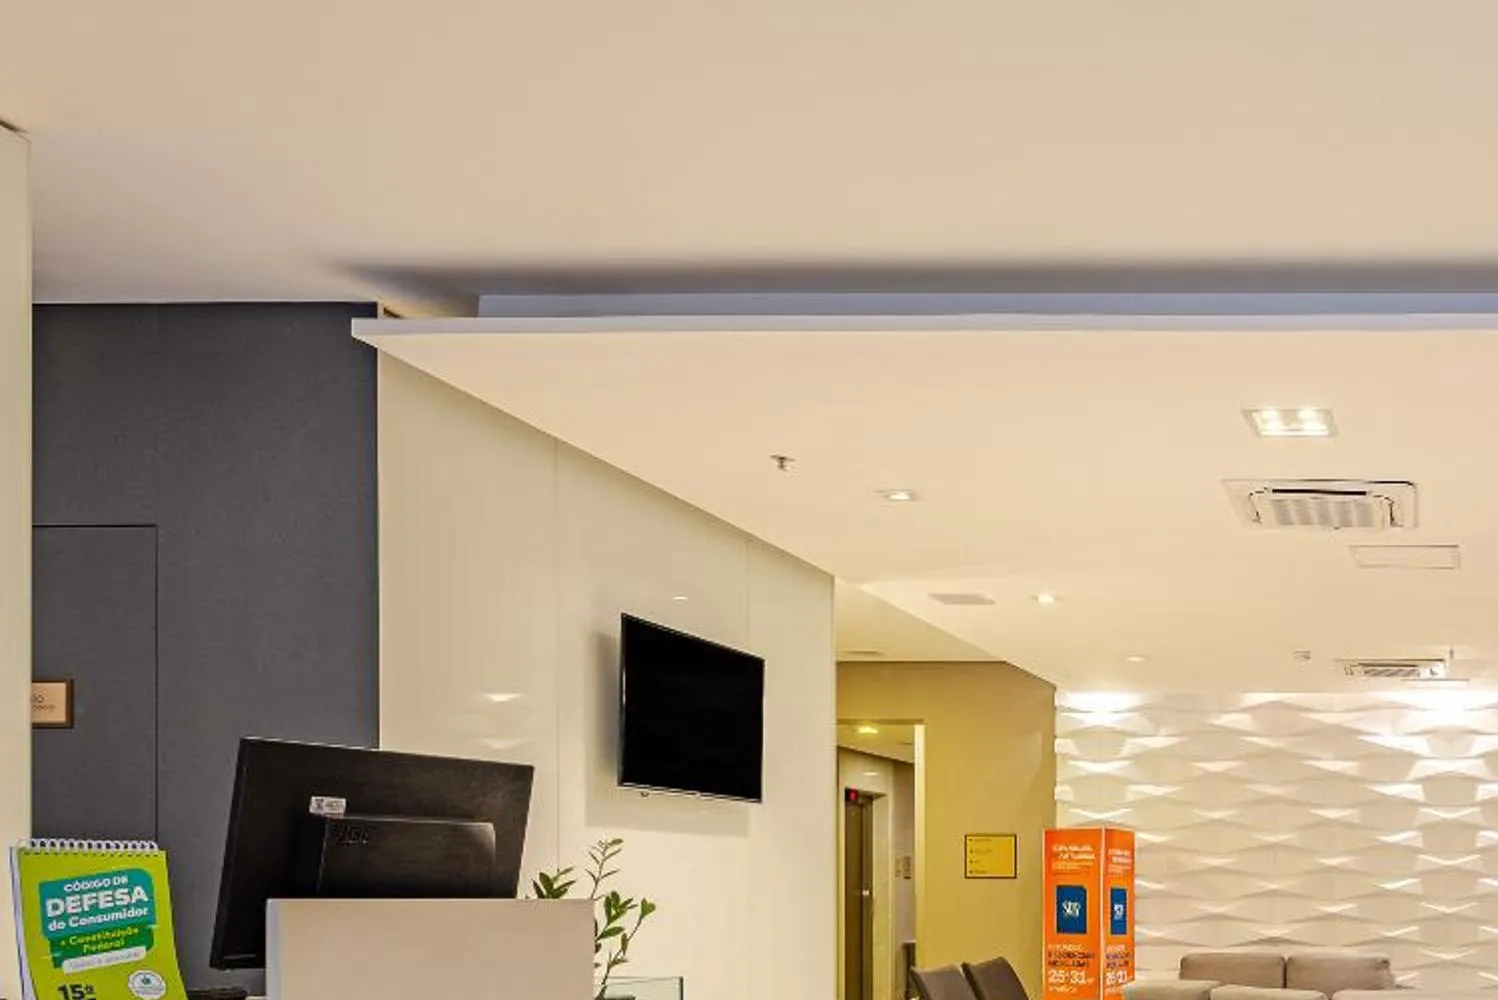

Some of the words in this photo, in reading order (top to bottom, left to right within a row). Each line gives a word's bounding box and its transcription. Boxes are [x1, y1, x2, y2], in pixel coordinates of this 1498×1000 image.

[46, 886, 148, 917] DEFESA
[48, 920, 67, 931] do
[68, 907, 149, 928] Consumidor
